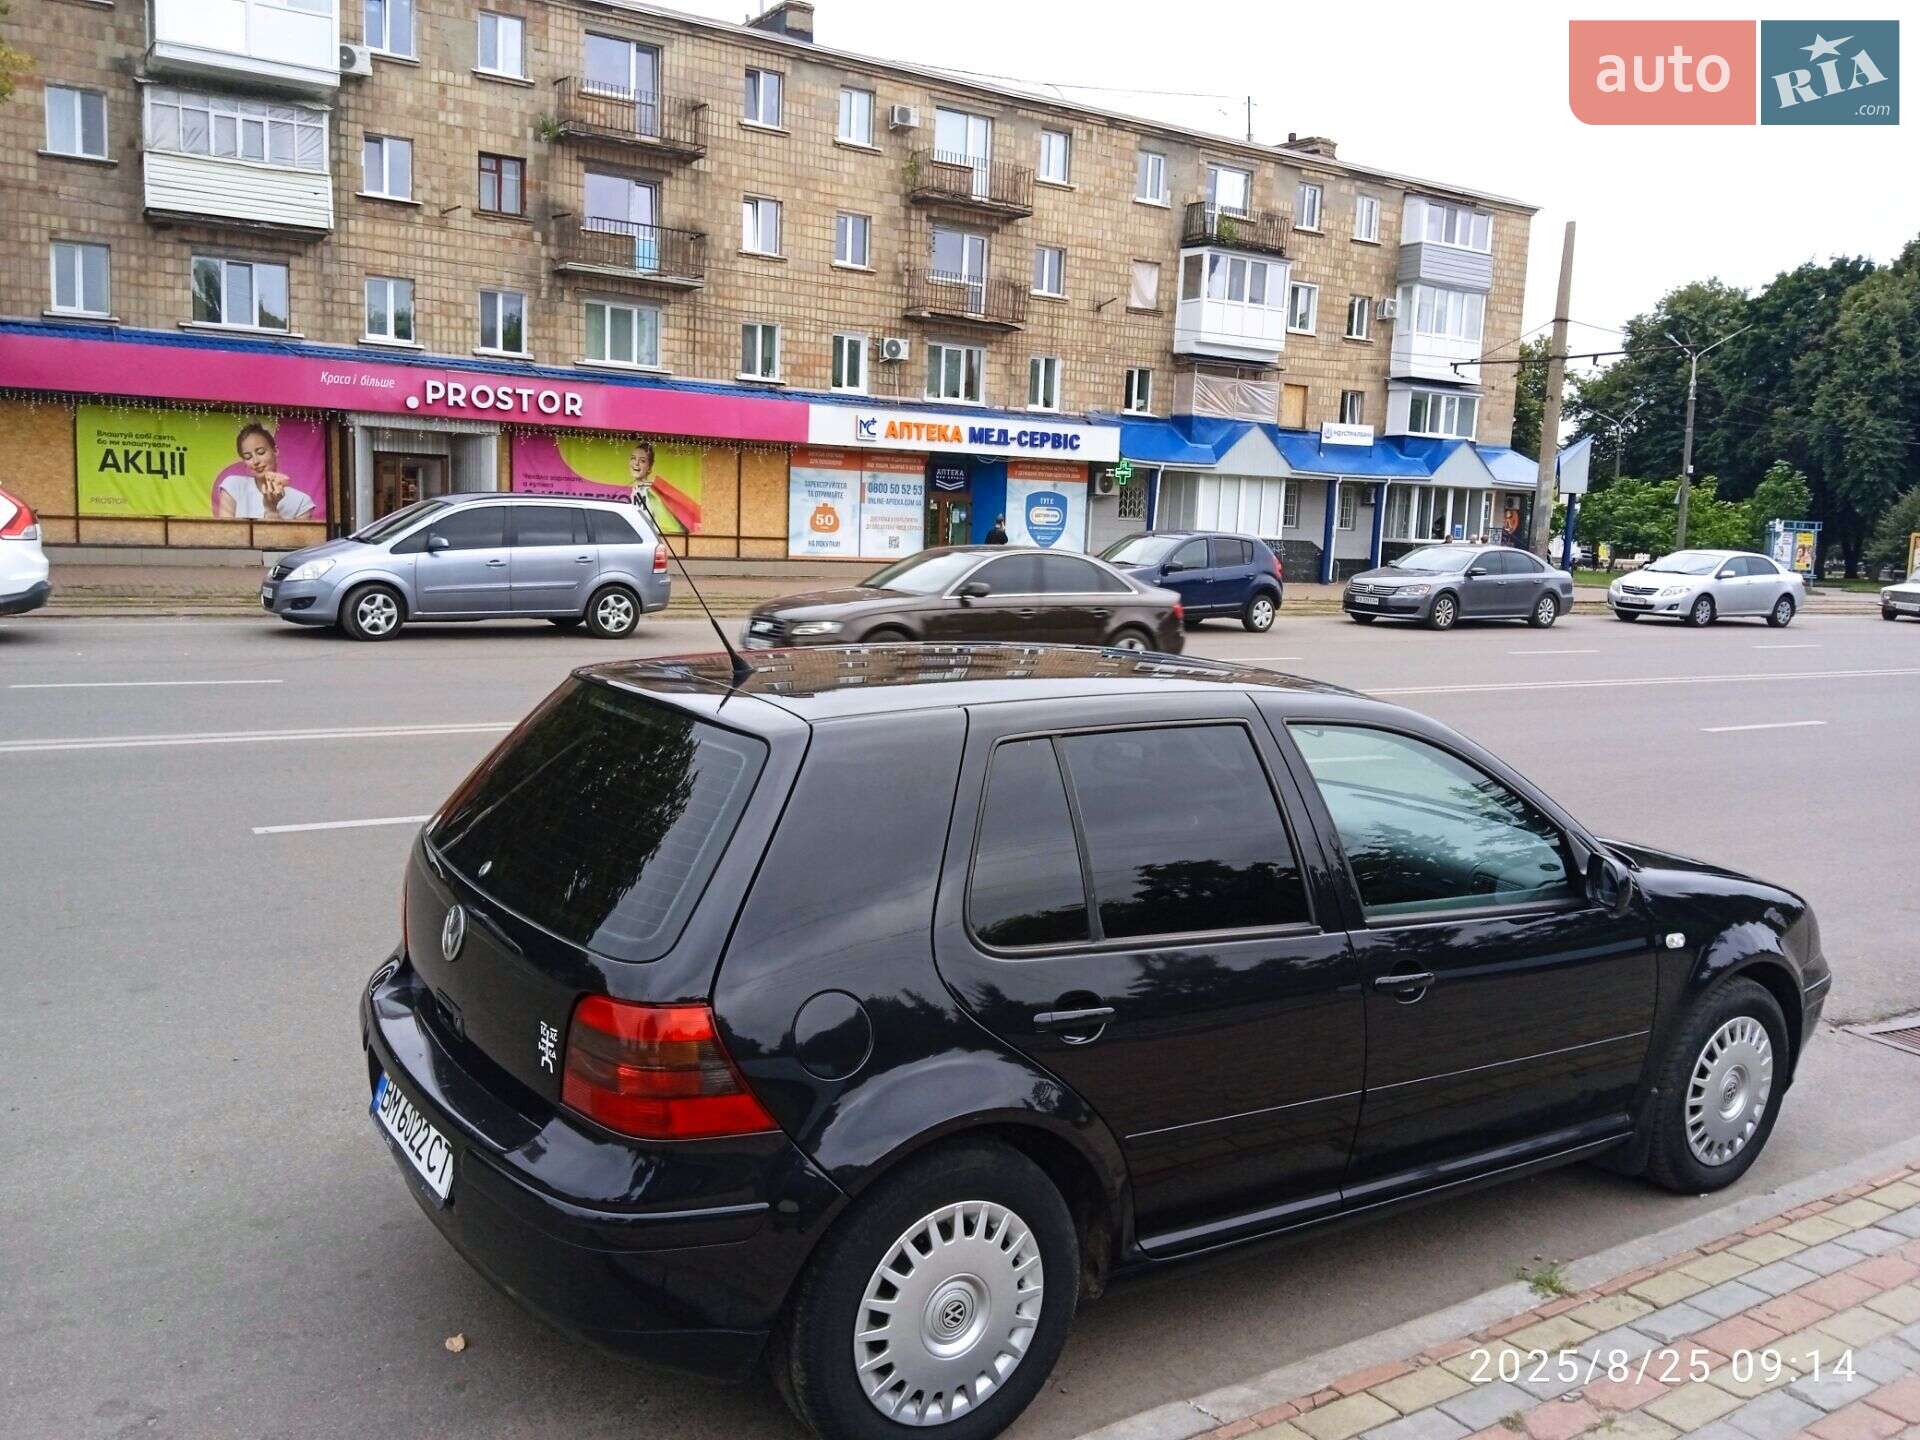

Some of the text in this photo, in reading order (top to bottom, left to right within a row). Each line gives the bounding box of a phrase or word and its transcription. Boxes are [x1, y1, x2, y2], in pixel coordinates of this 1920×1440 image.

[320, 371, 350, 385] Краса
[360, 377, 395, 389] більше
[96, 429, 133, 439] Влаштуй
[885, 420, 1081, 450] АПТЕКА МЕД-СЕРВІС
[98, 446, 188, 480] АКЦІЇ
[868, 482, 889, 494] 0800
[890, 483, 900, 495] 50
[816, 513, 834, 526] 50
